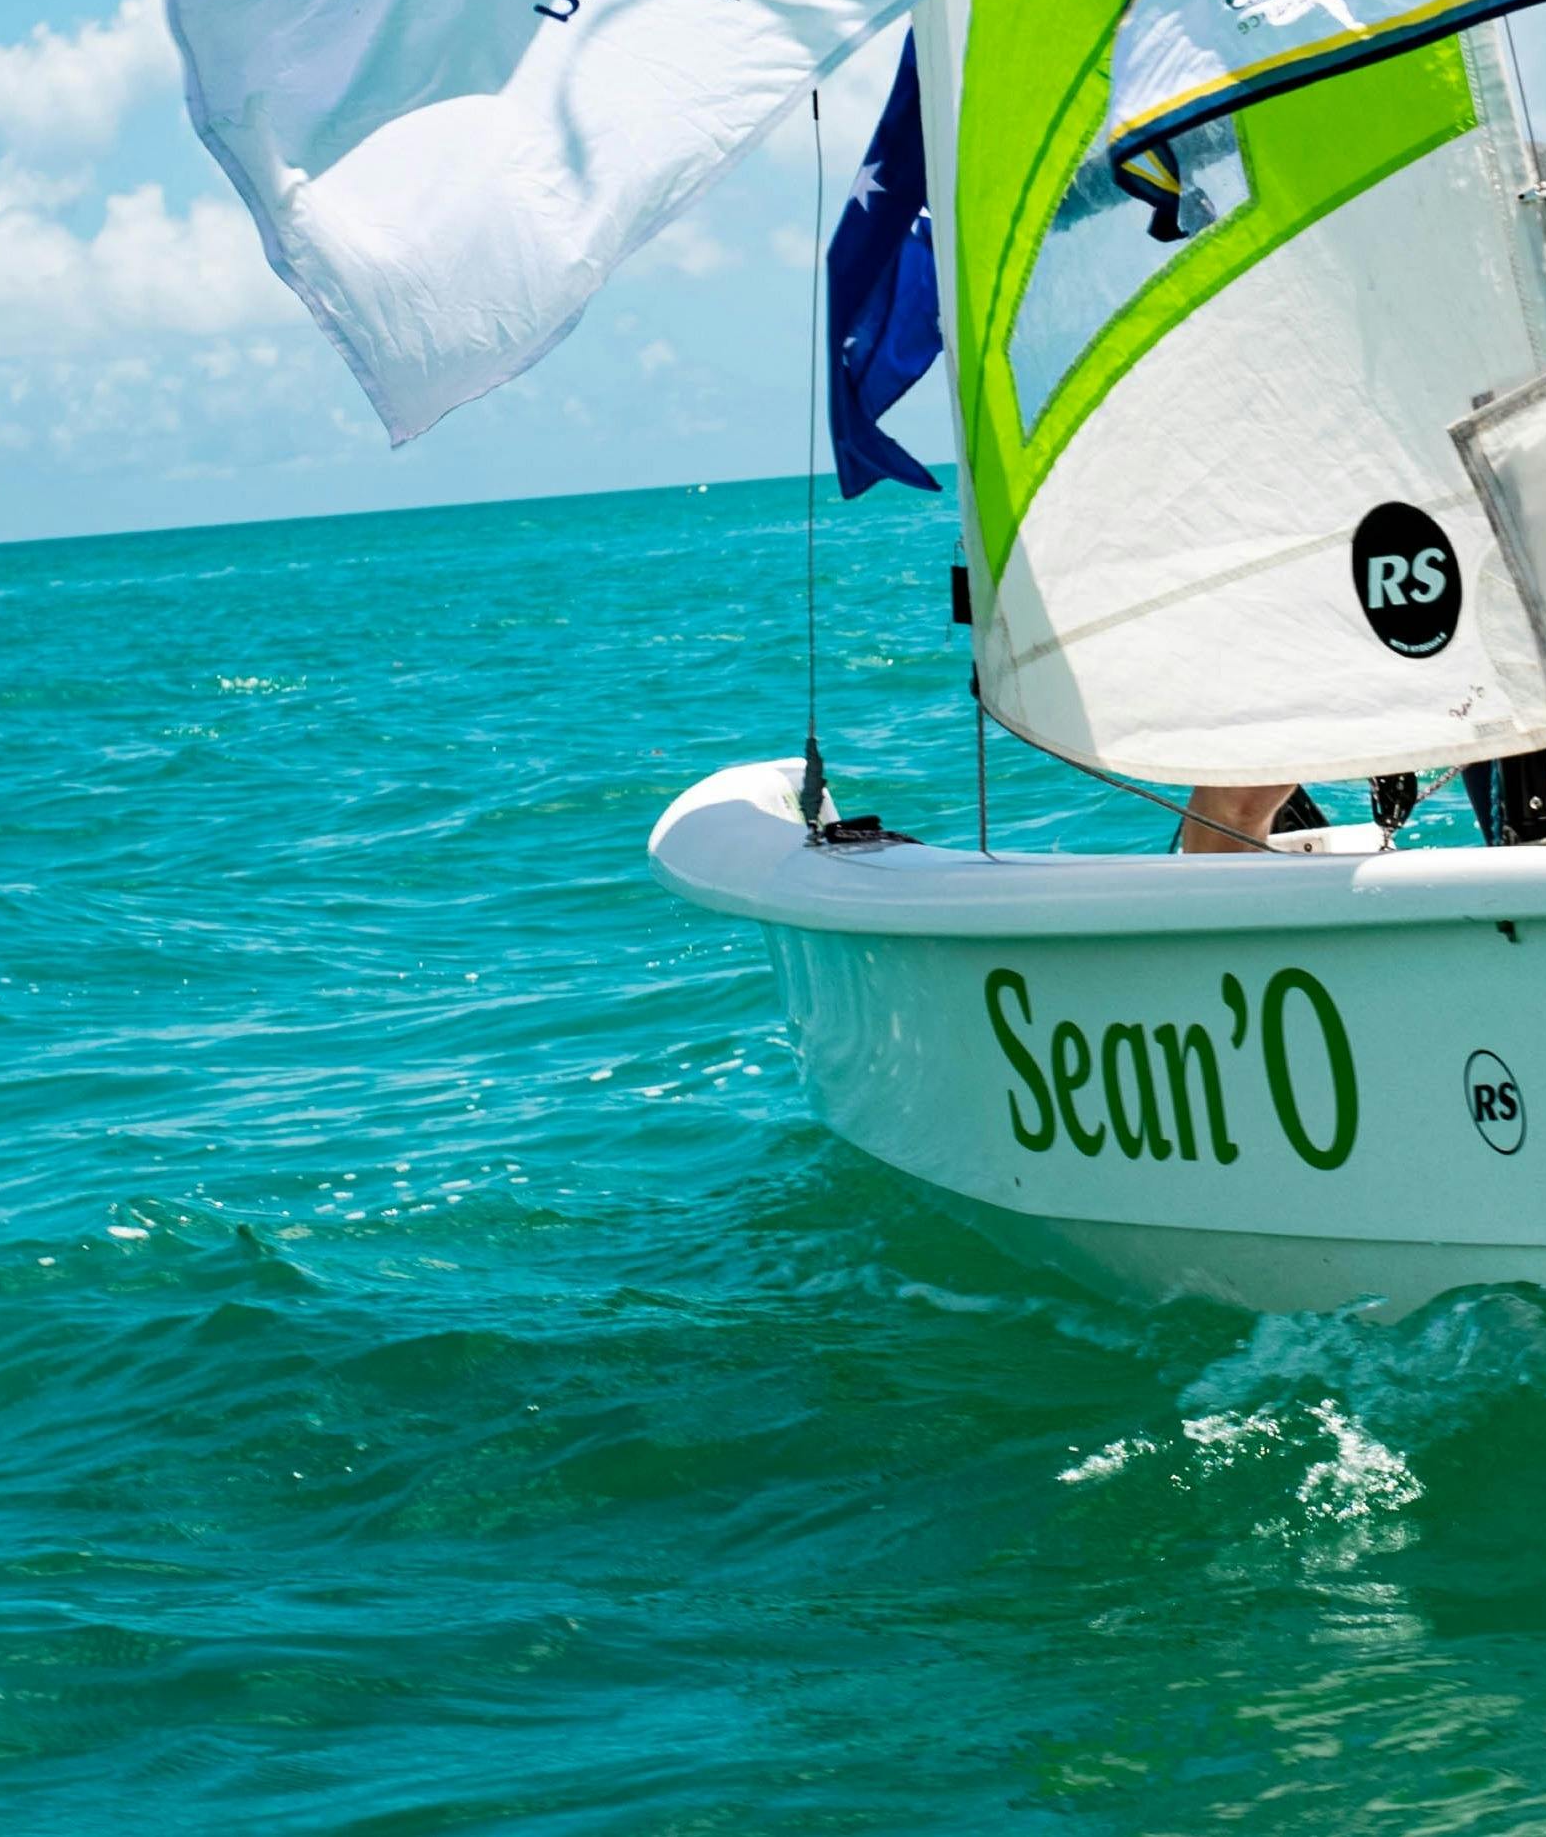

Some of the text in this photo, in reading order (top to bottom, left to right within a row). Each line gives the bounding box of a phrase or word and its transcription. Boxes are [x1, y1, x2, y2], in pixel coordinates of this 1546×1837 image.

[1368, 547, 1447, 609] RS
[984, 967, 1359, 1171] Sean'O
[1474, 1081, 1518, 1122] RS
